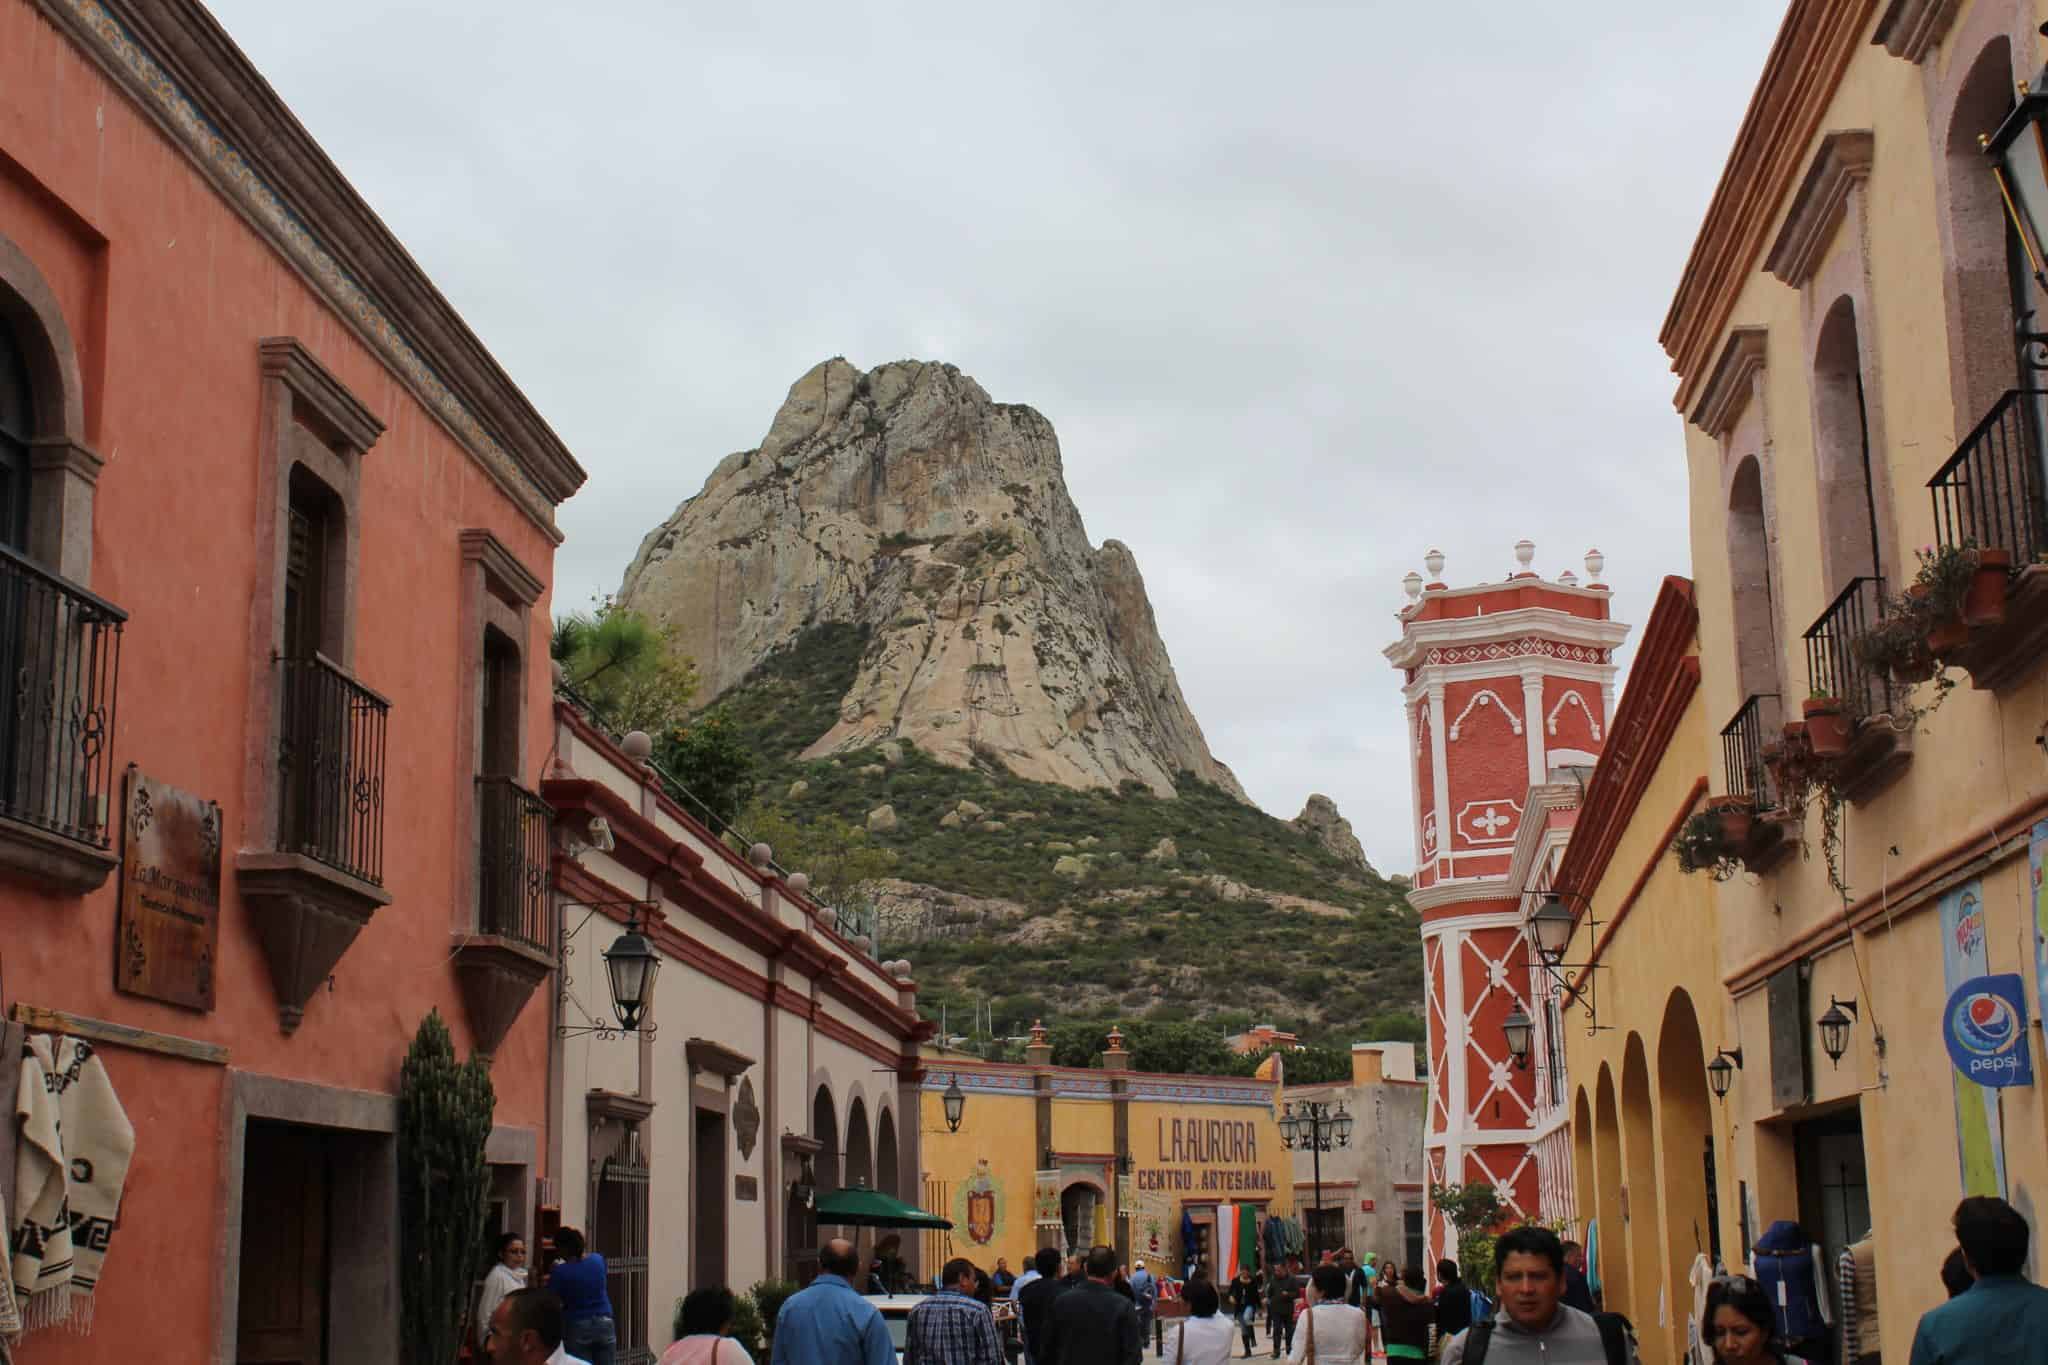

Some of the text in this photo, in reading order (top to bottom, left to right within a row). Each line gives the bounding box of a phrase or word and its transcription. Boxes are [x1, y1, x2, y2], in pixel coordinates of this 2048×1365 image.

[1970, 1055, 2017, 1074] pepsi
[1187, 1118, 1257, 1163] AURORA
[1138, 1169, 1276, 1190] CENTRO ARTESANAL
